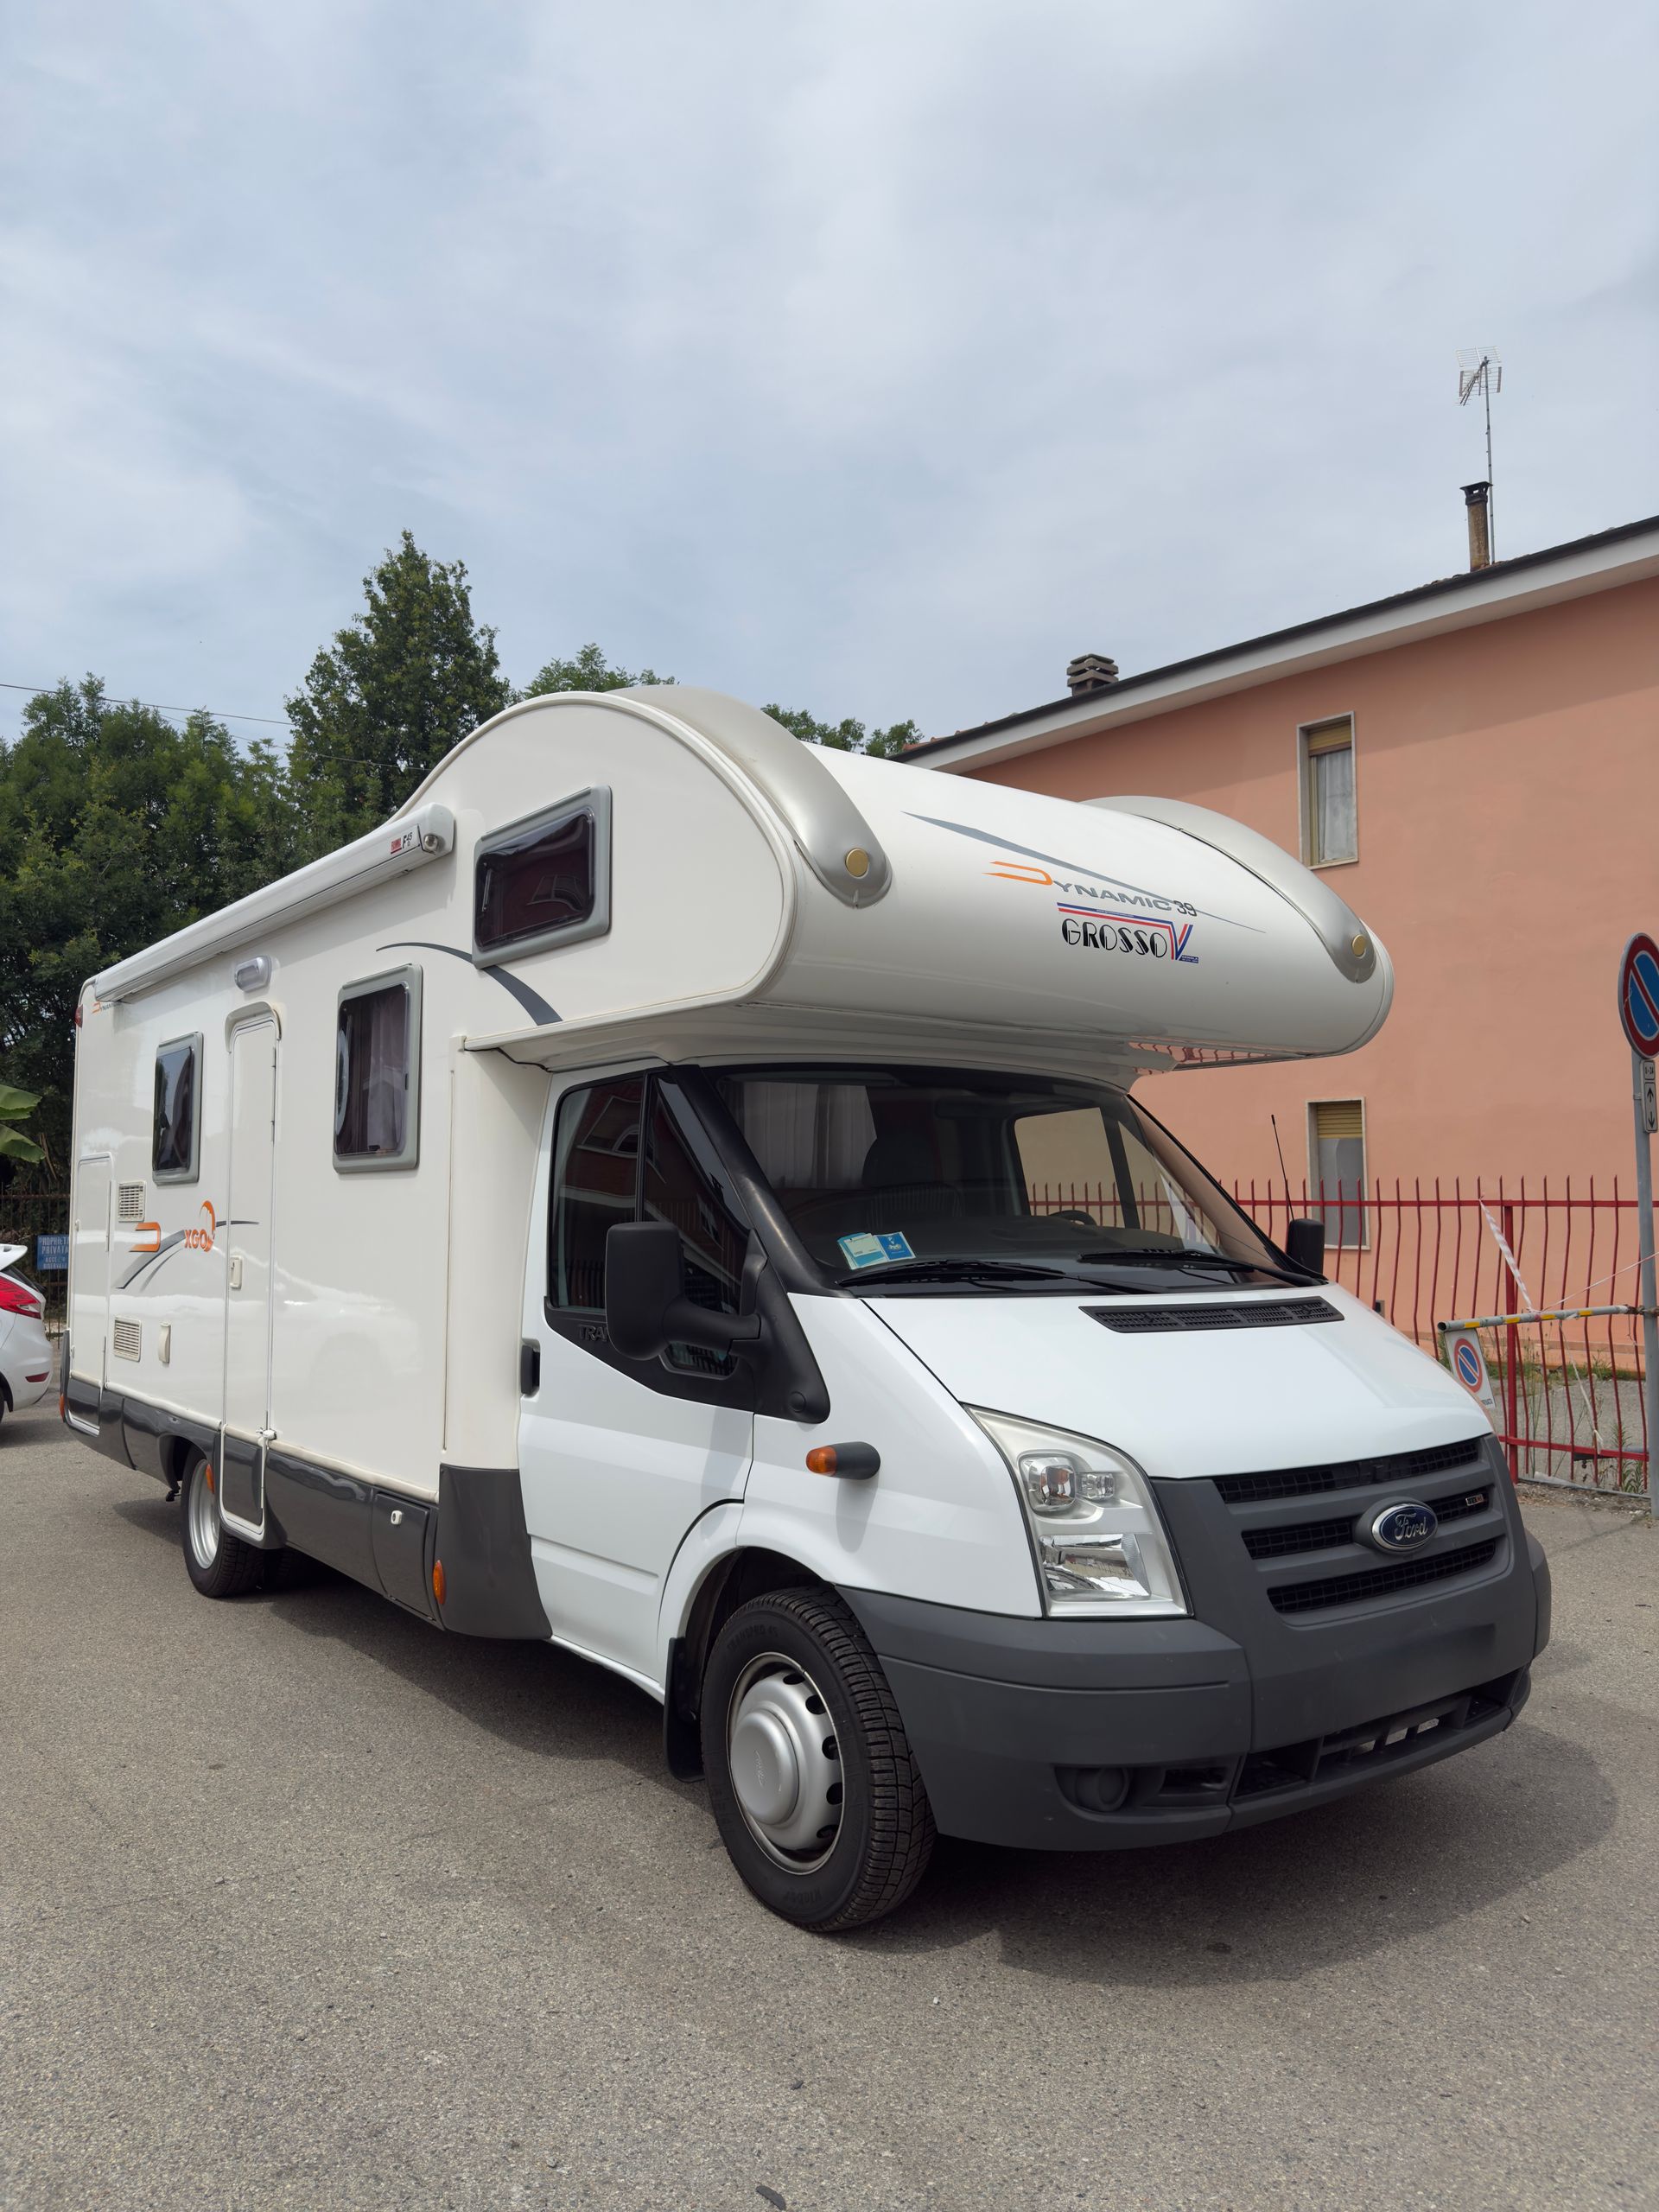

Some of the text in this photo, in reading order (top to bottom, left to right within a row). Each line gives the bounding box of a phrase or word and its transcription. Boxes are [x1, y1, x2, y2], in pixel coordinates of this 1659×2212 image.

[982, 861, 1198, 917] DYNAMIC 39
[1062, 918, 1168, 958] GROSSO
[1394, 1512, 1428, 1541] Ford
